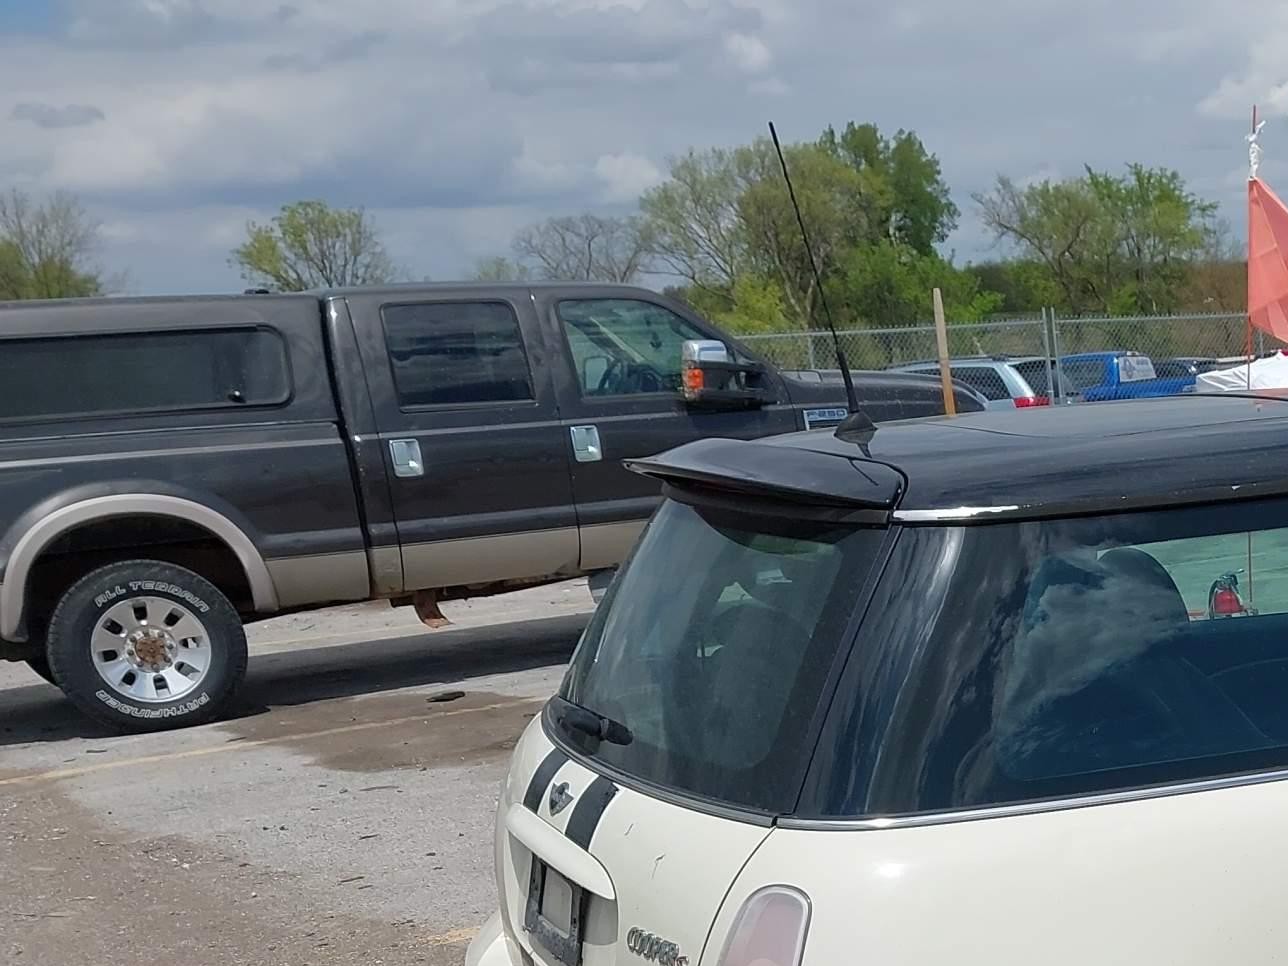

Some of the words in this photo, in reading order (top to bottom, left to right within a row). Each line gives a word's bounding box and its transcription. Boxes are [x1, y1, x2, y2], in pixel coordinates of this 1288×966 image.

[95, 586, 126, 607] ALL
[130, 581, 210, 612] TERRAIN
[96, 690, 210, 718] PATHFINDER
